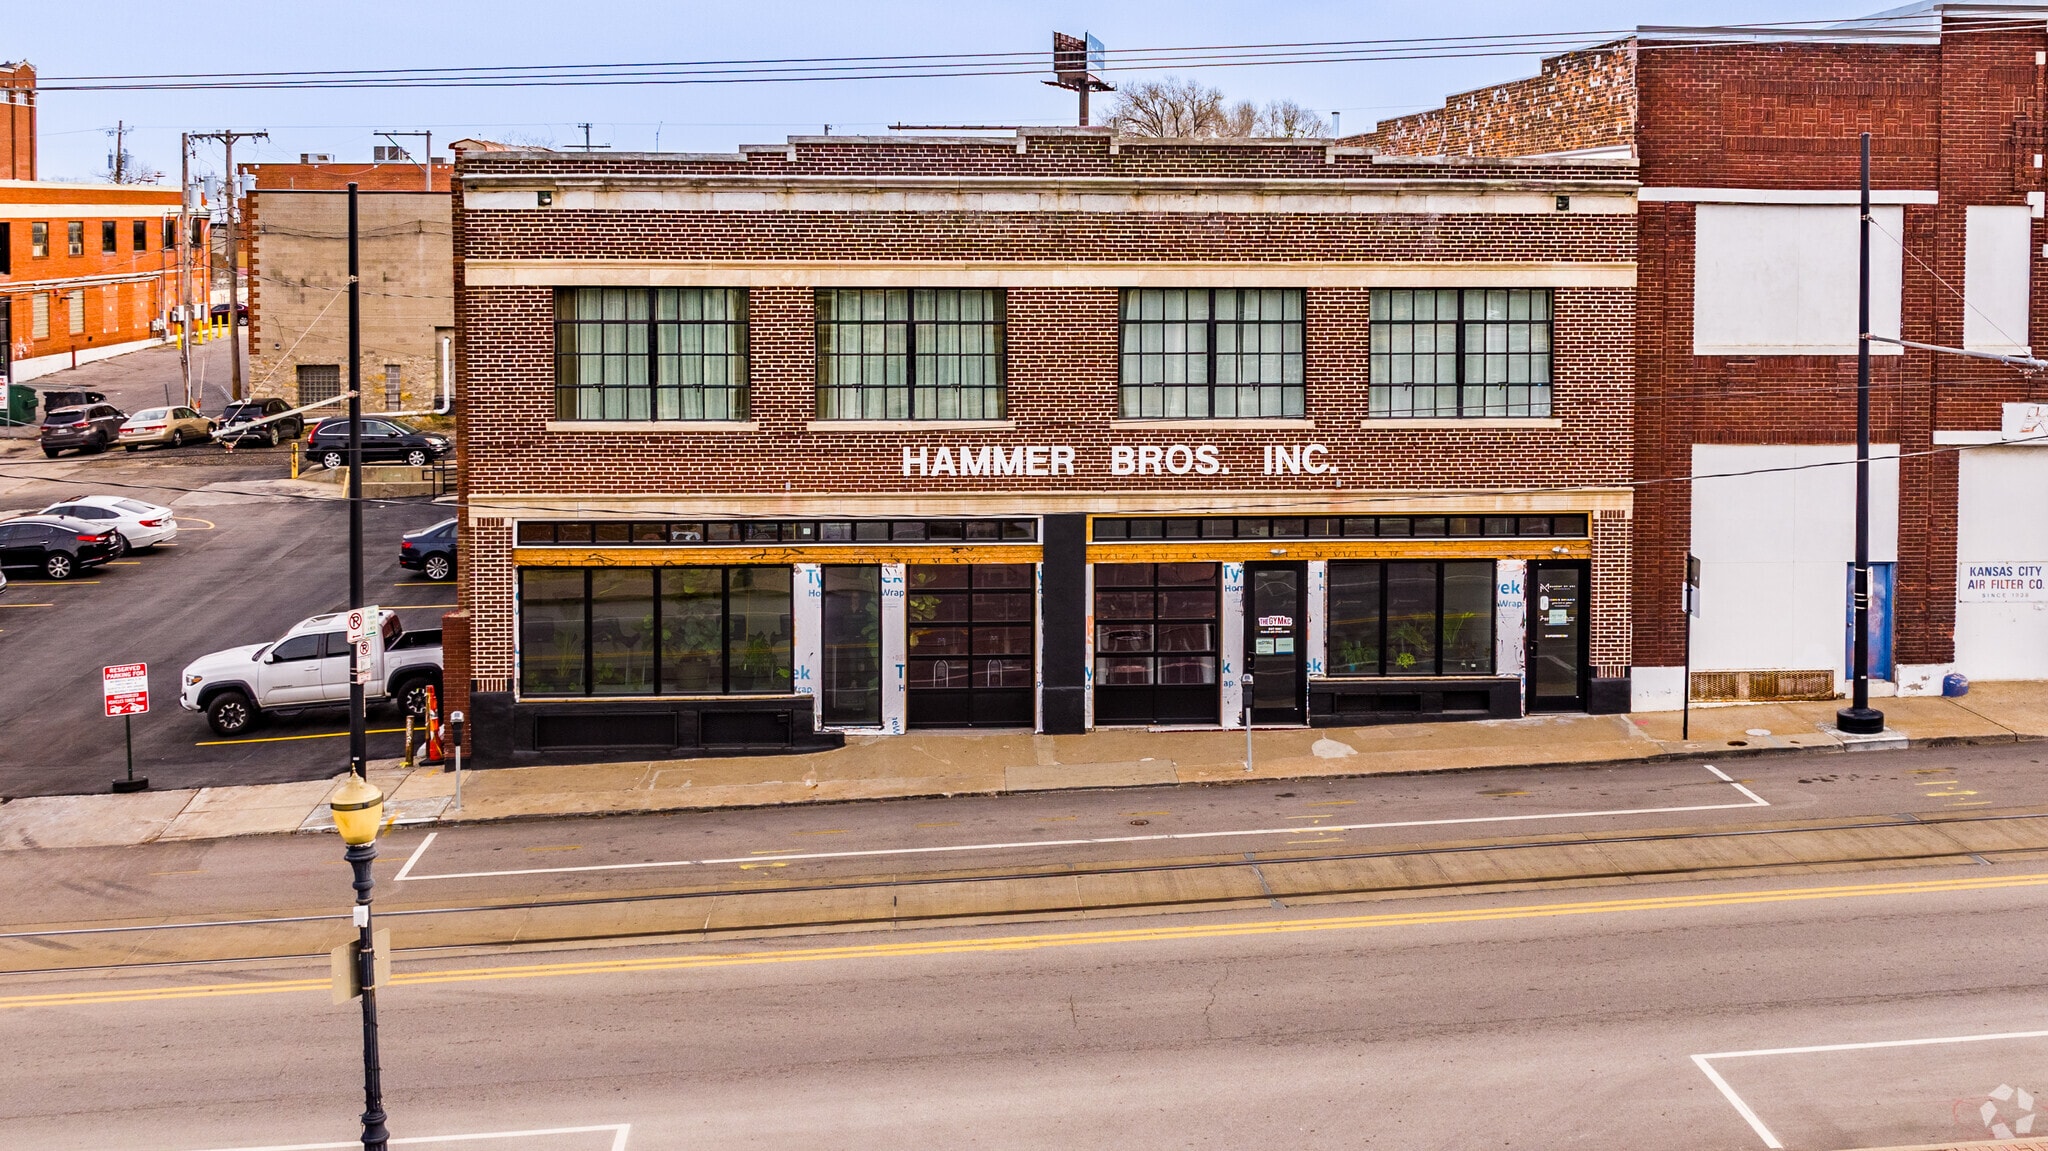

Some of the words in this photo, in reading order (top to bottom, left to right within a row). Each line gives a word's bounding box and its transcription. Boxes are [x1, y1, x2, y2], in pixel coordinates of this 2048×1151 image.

[902, 446, 1076, 477] HAMMER
[1111, 444, 1229, 475] BROS.
[1263, 444, 1337, 475] INC.
[1969, 566, 2013, 577] KANSAS
[2018, 566, 2042, 577] CITY
[1967, 579, 1986, 590] AIR
[1991, 579, 2024, 590] FILTER
[2029, 578, 2045, 590] CO.
